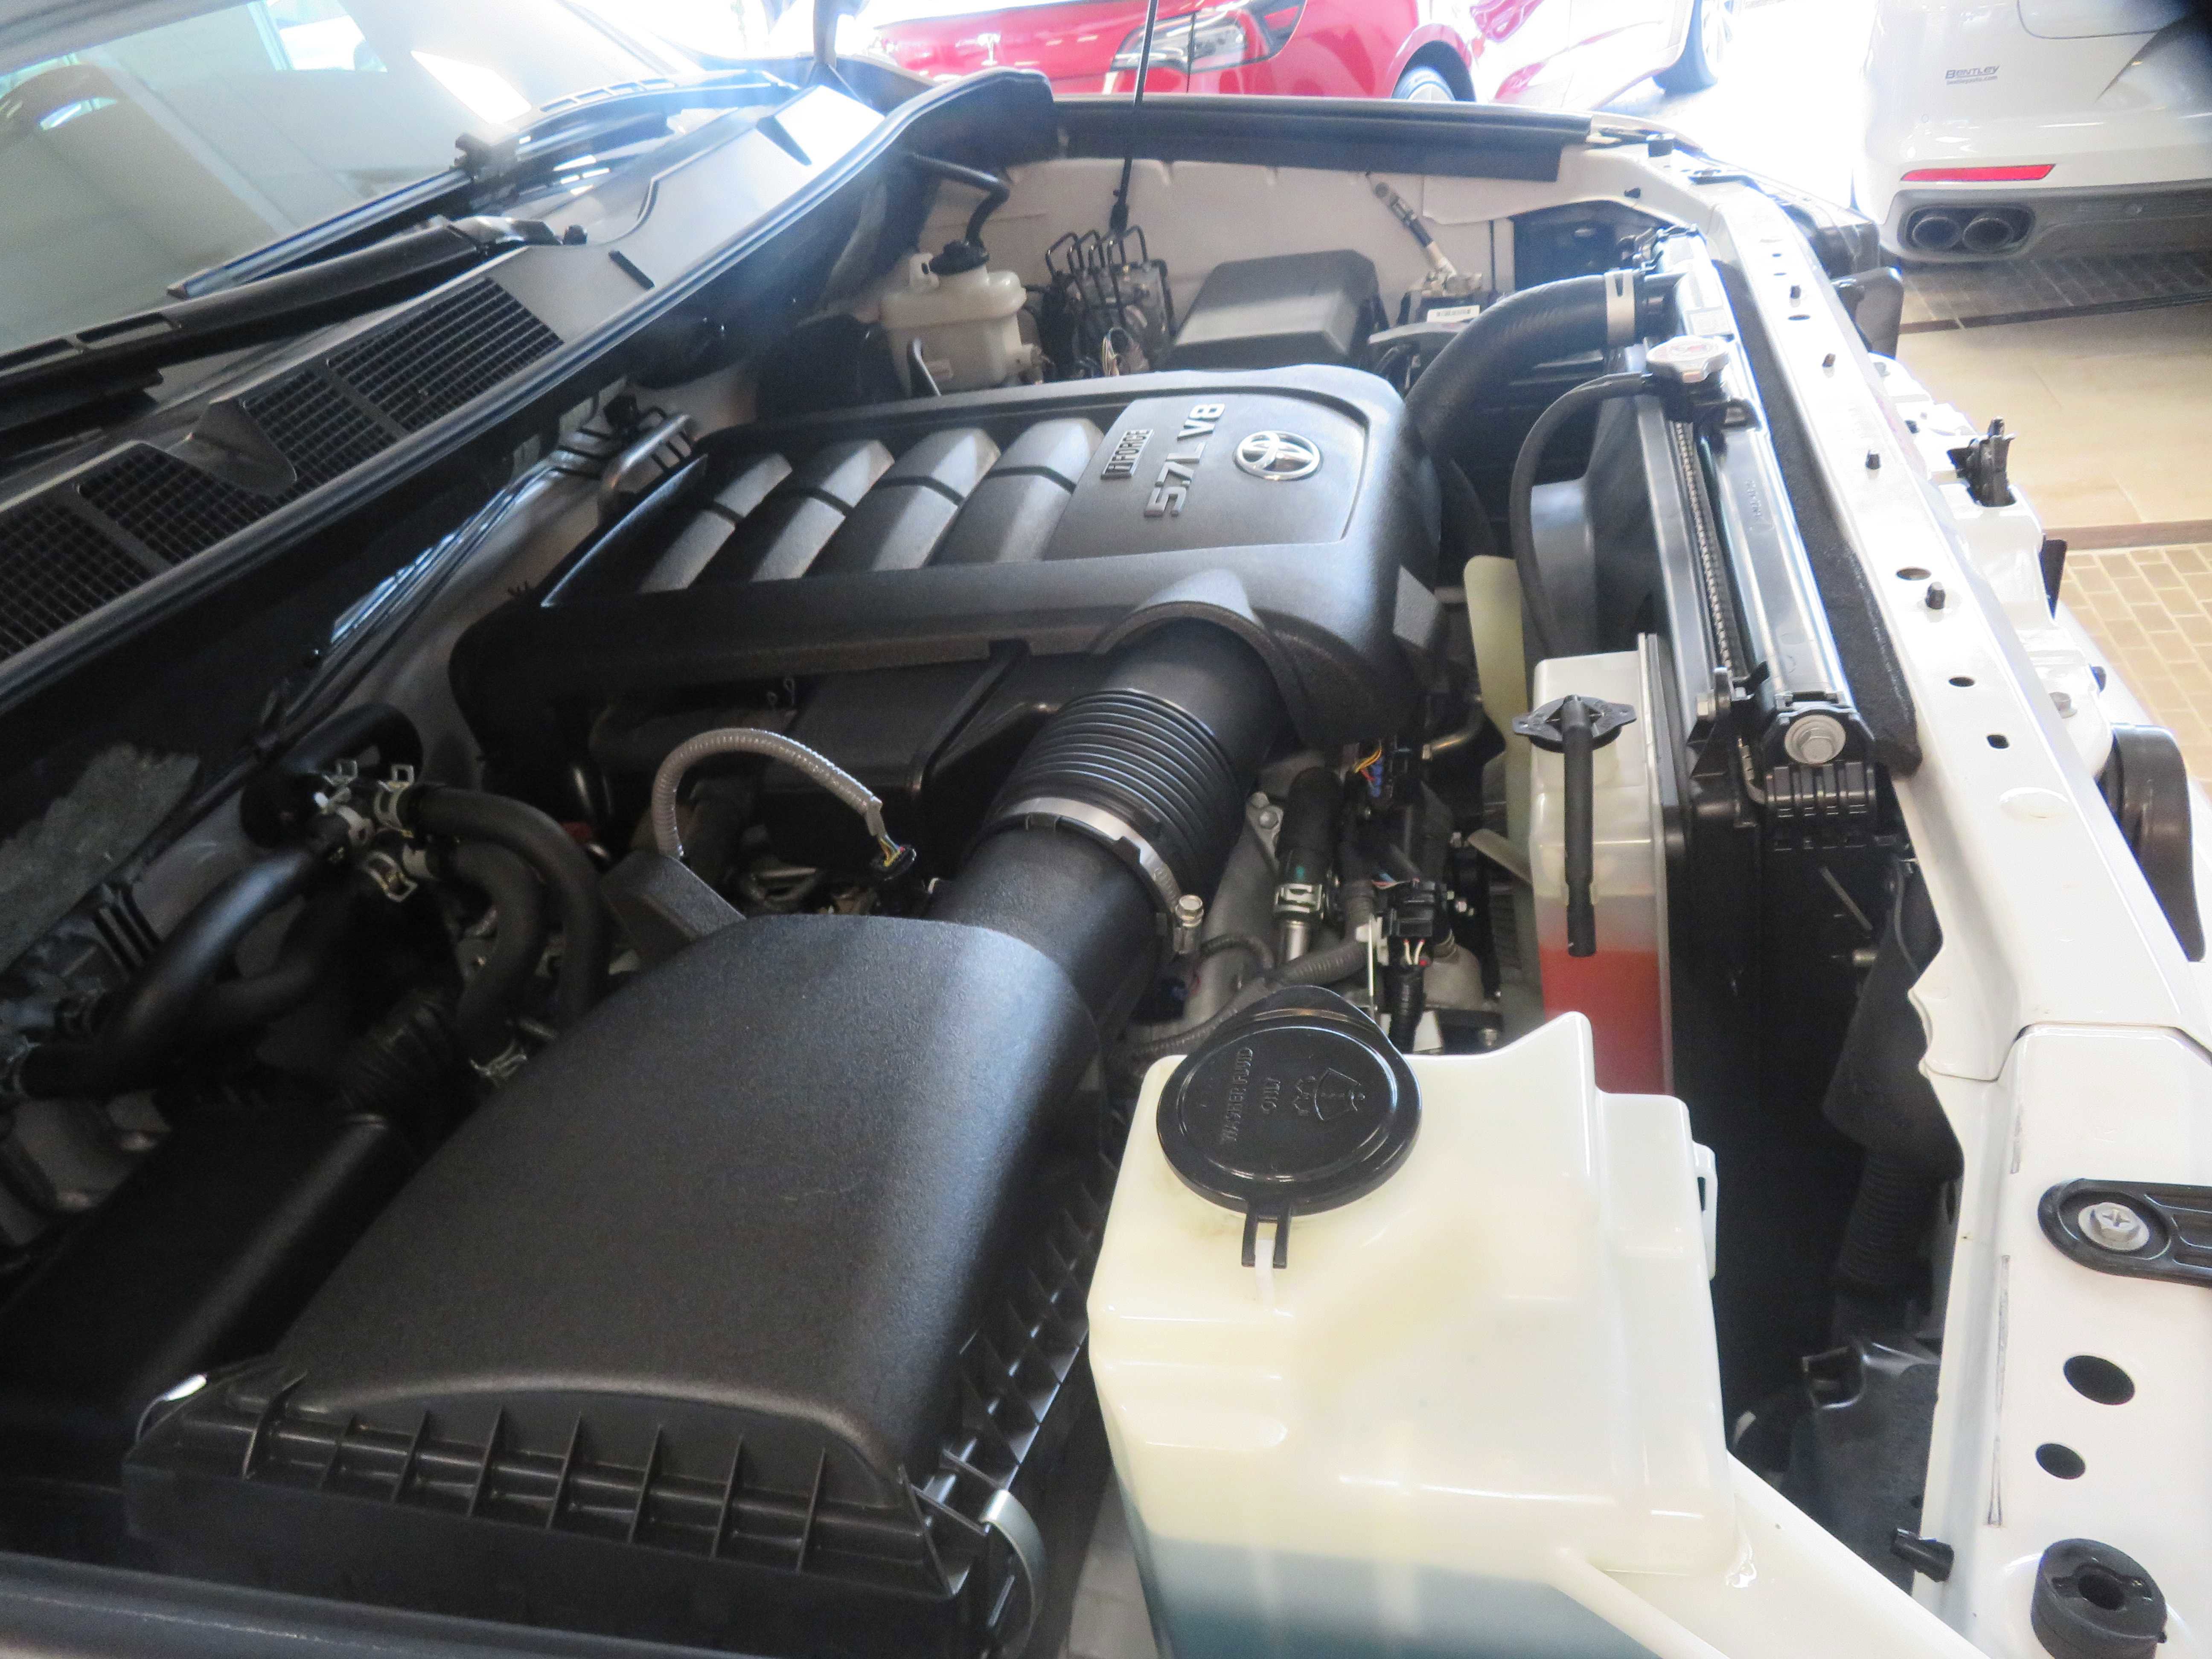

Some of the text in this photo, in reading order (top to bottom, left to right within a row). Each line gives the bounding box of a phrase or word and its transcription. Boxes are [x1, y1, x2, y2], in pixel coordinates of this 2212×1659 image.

[1145, 403, 1225, 515] 5.7L V8
[1222, 1048, 1253, 1143] WASHER FLUID
[1260, 1077, 1281, 1113] ONLY
